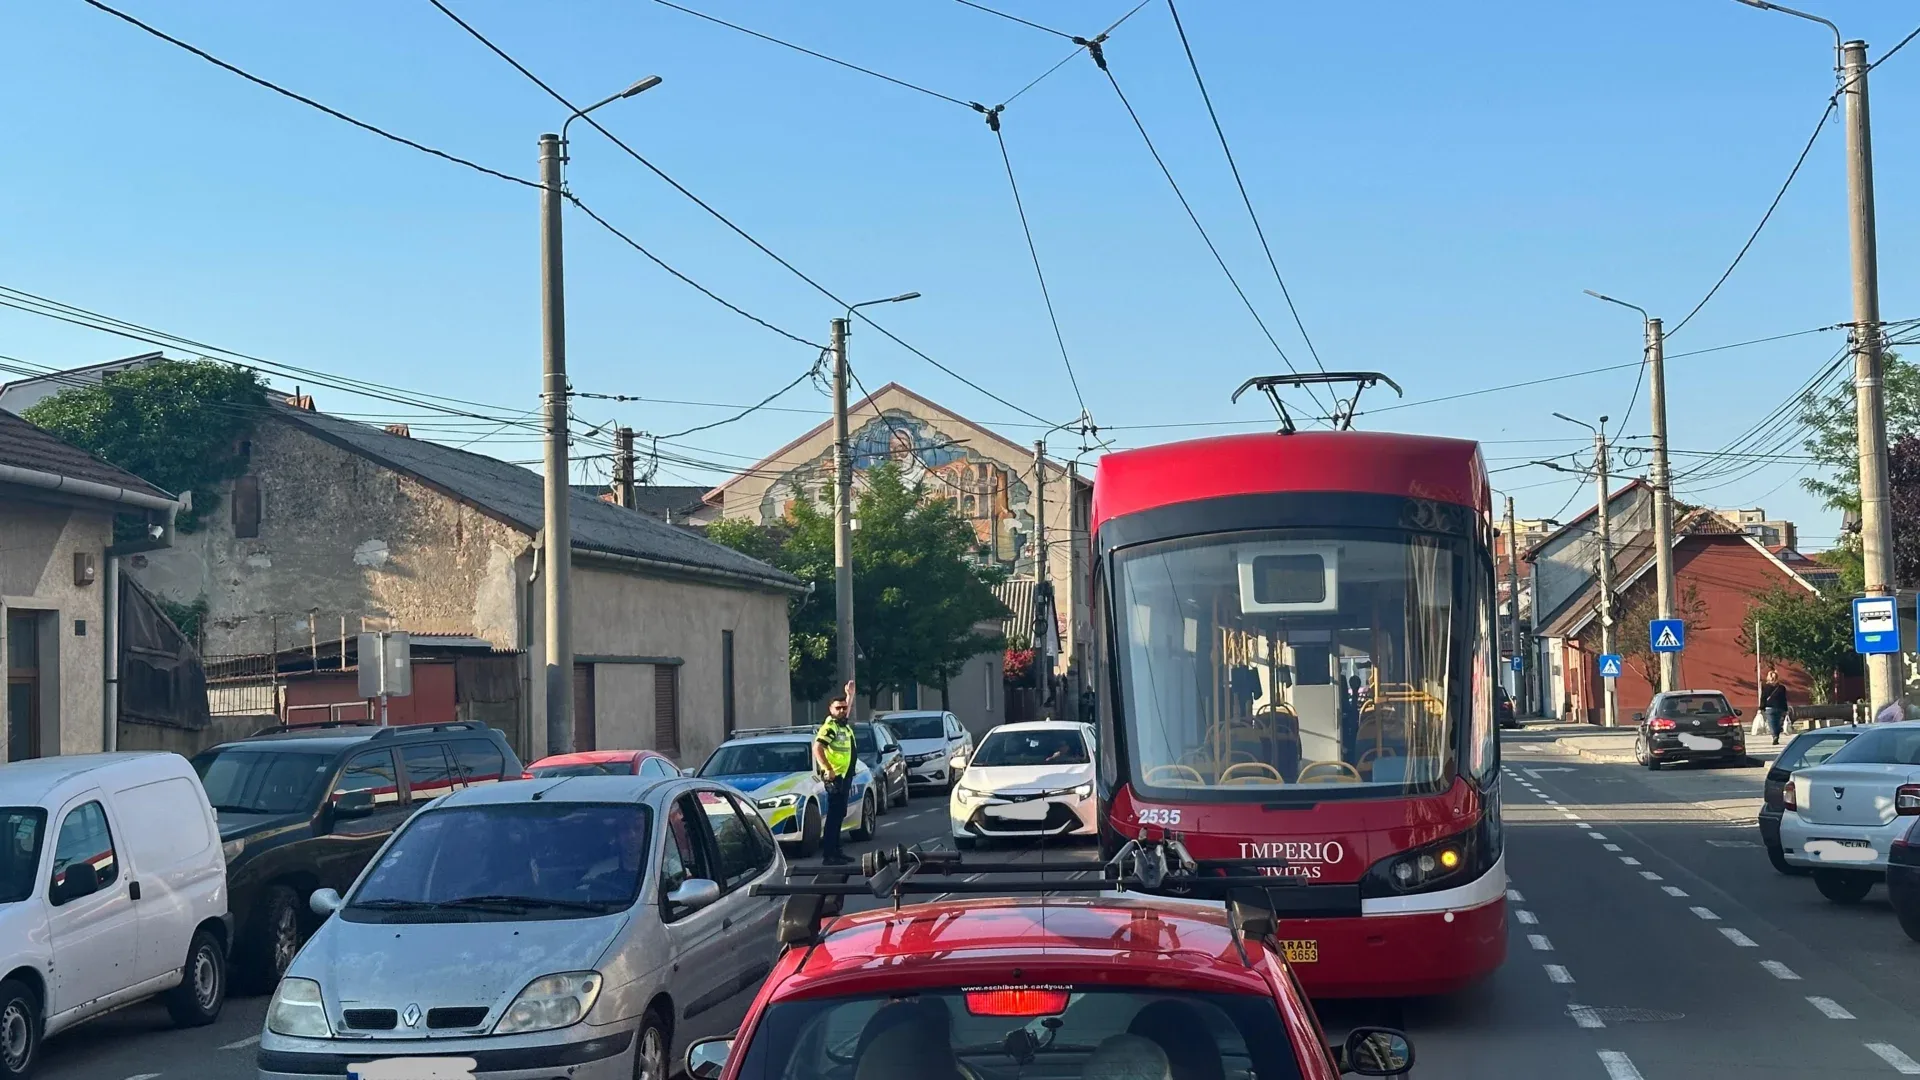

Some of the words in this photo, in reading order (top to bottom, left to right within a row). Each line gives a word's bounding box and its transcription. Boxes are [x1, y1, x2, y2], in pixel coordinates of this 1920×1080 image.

[1138, 809, 1181, 824] 2535
[1238, 841, 1344, 864] IMPERIO
[1291, 950, 1317, 960] 3653
